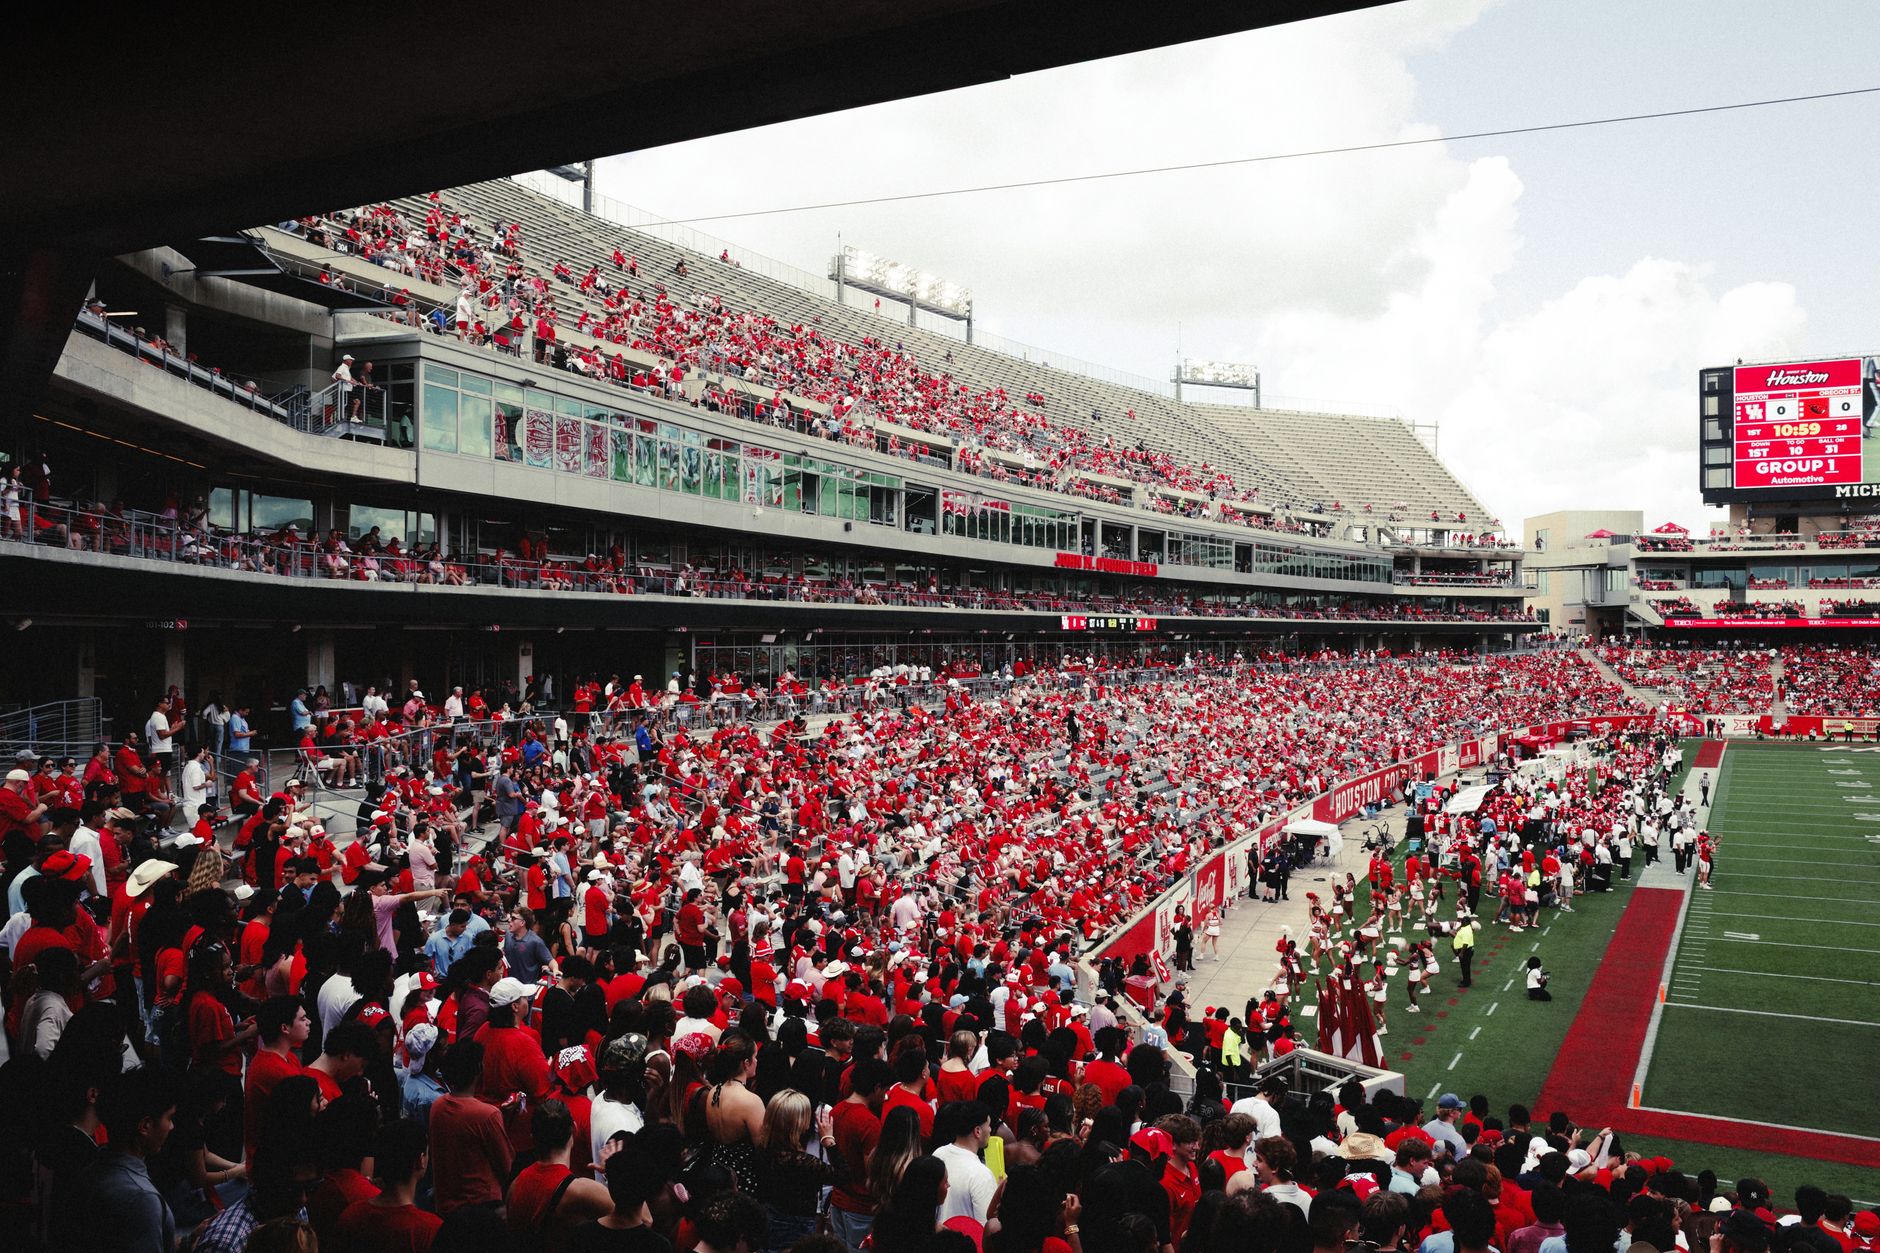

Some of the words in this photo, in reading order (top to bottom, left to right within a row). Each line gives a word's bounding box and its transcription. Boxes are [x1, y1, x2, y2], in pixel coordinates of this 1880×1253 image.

[1766, 369, 1829, 386] Houston
[1819, 389, 1849, 397] OREGON
[1777, 406, 1786, 415] 0
[1842, 402, 1850, 411] 0
[1773, 422, 1821, 437] 10:59
[1748, 448, 1770, 457] 1ST
[1789, 446, 1803, 455] 10
[1825, 444, 1838, 453] 31
[1756, 460, 1824, 475] GROUP
[1771, 475, 1824, 484] Automotive
[1336, 777, 1381, 819] HOUSTON
